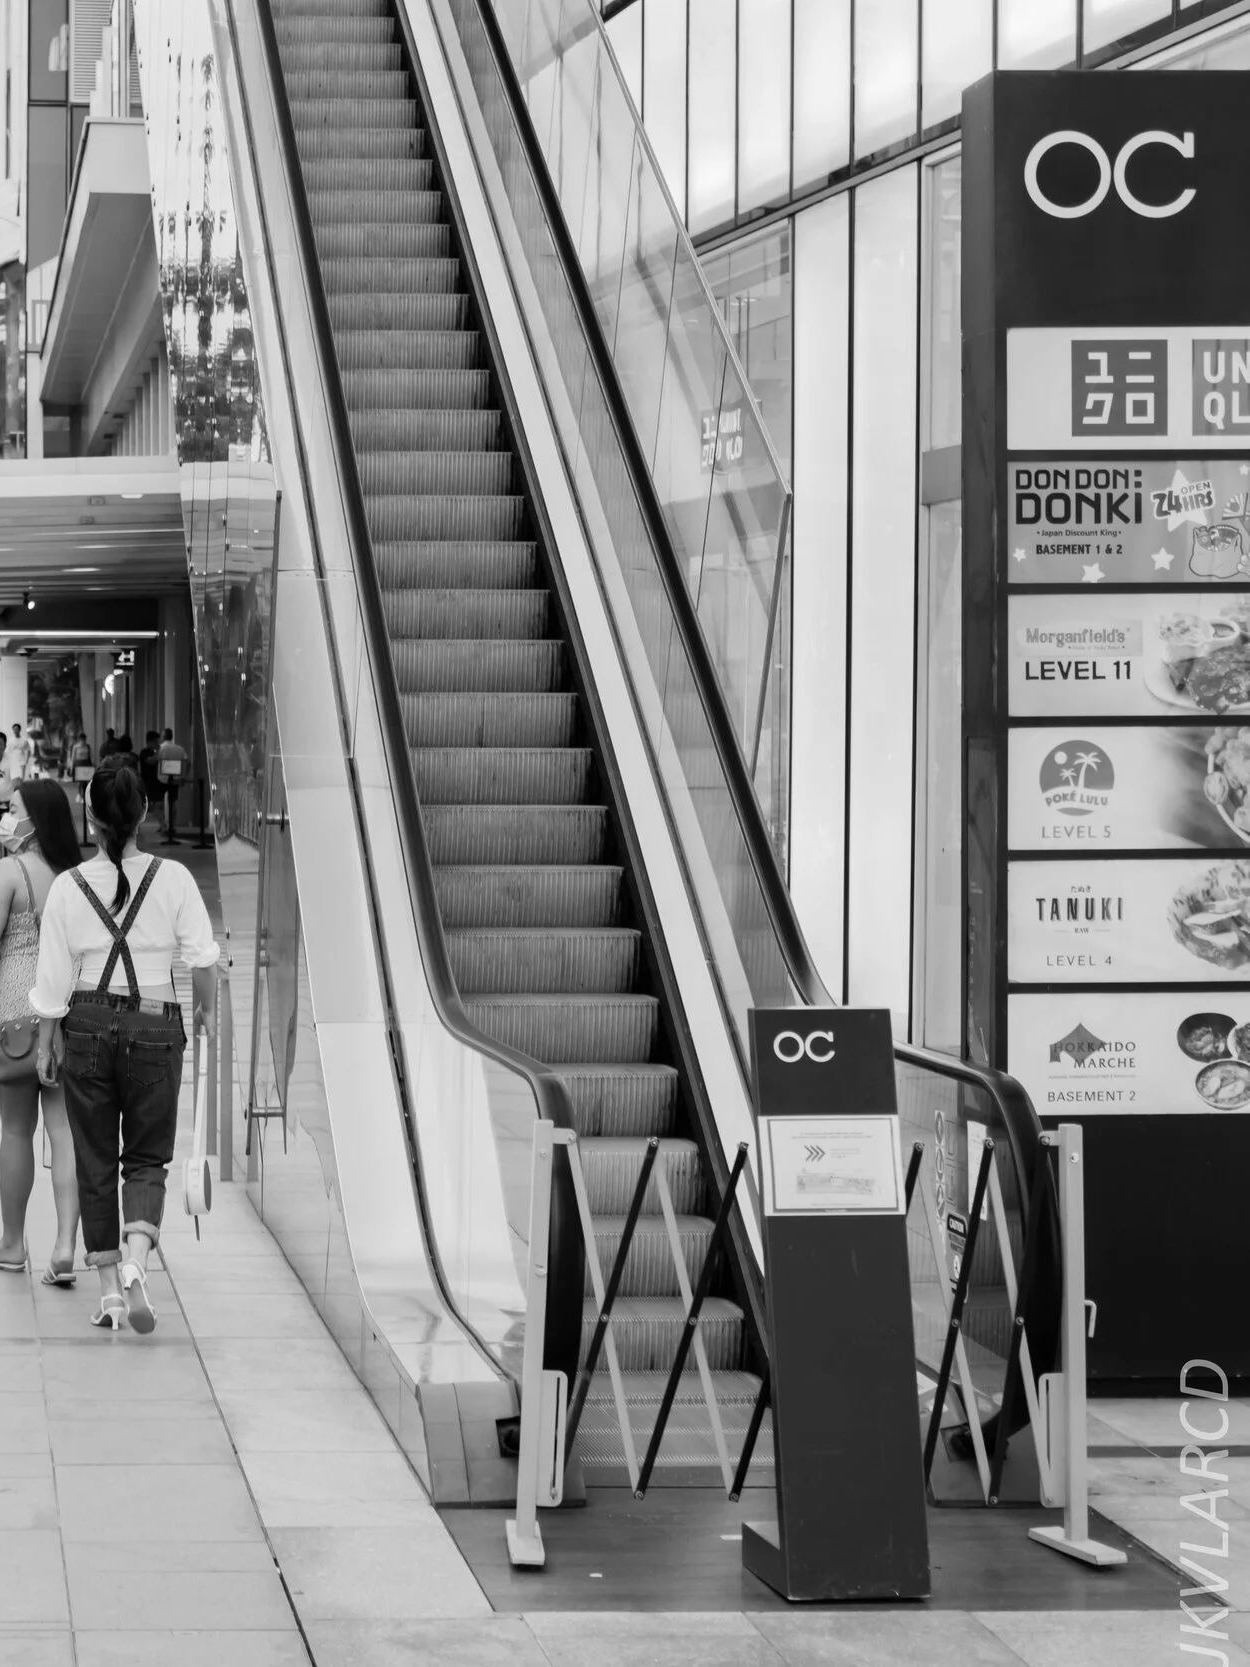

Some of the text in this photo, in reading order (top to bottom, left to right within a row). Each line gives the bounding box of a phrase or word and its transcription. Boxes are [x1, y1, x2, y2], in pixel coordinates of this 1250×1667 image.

[1023, 130, 1197, 219] OC
[1180, 481, 1211, 495] OPEN
[1015, 492, 1142, 524] DONKI
[1041, 529, 1118, 538] Japan Discount King
[1036, 544, 1123, 555] BASEMENT 1 & 2
[1025, 627, 1126, 648] Morganfield's
[1025, 660, 1131, 680] LEVEL 11
[1045, 790, 1109, 807] POKÉ LULU
[1041, 825, 1112, 839] LEVEL 5
[1035, 897, 1124, 921] TANUKI
[1046, 955, 1112, 967] LEVEL 4
[773, 1030, 836, 1063] OC
[1053, 1041, 1137, 1053] HOKKAIDO
[1073, 1057, 1137, 1069] MARCHE
[1047, 1090, 1137, 1102] BASEMENT 2
